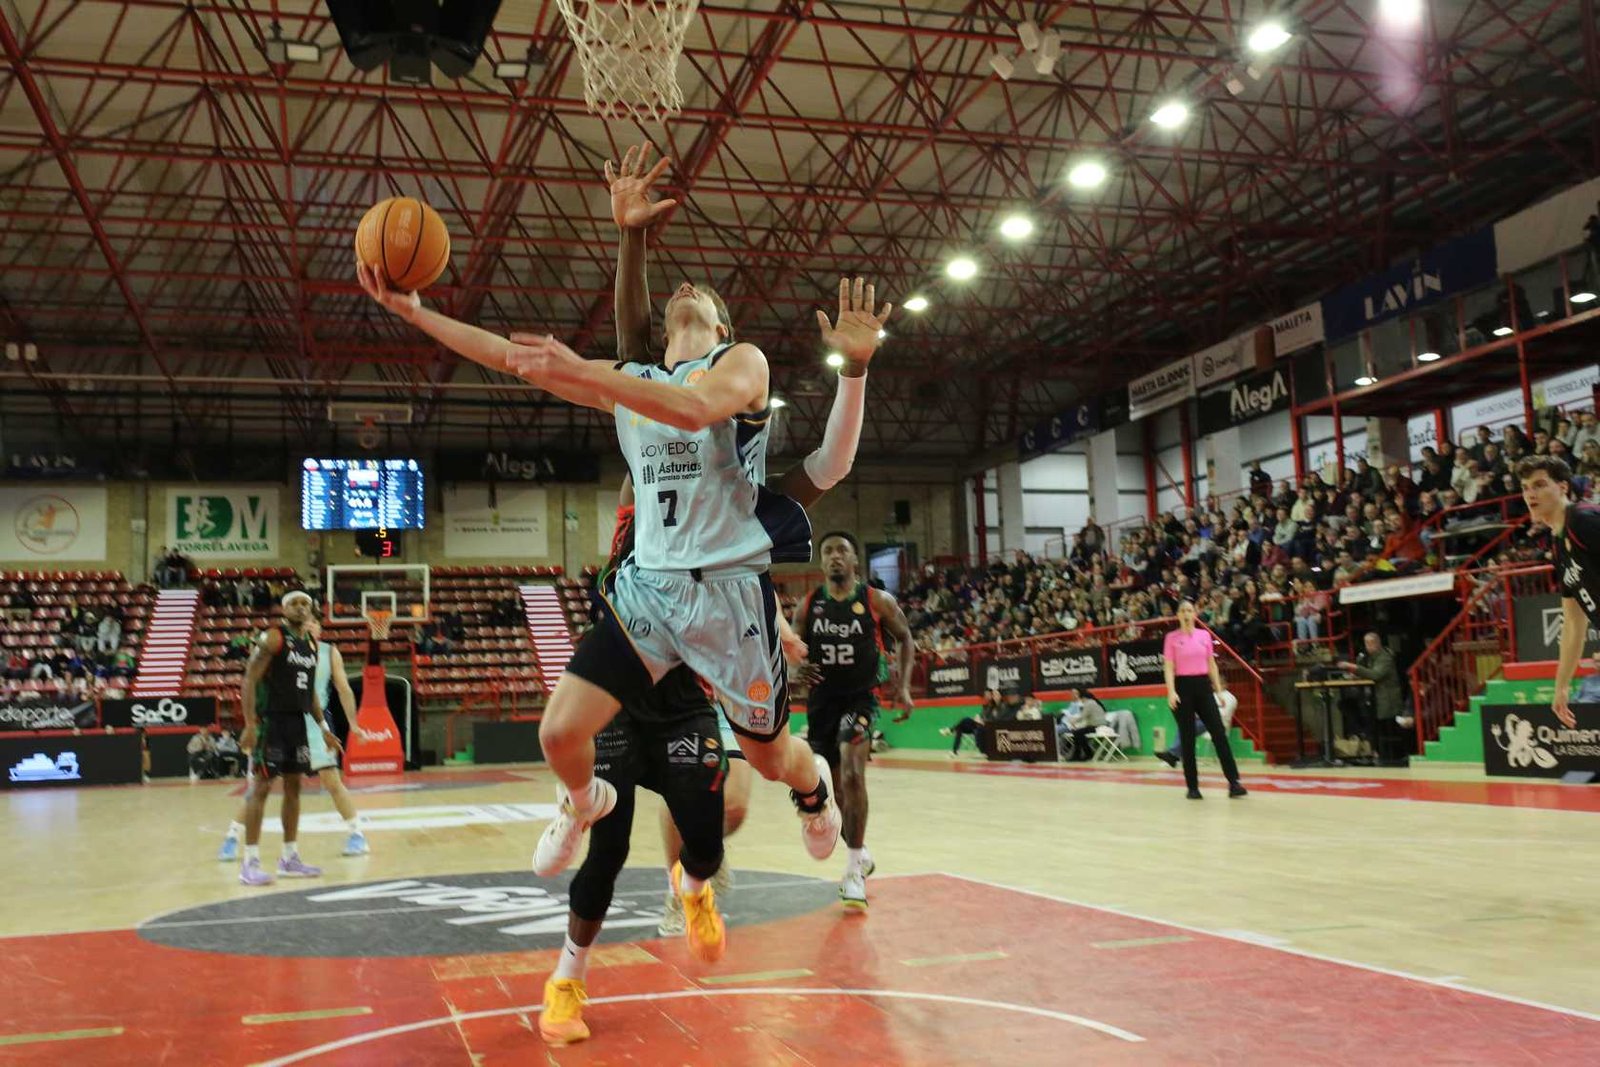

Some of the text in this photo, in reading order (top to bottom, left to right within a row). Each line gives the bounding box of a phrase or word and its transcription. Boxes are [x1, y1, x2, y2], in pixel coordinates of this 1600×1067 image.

[1275, 311, 1312, 334] MALETA
[1230, 370, 1288, 415] AlegA
[645, 441, 699, 457] OVIEDO
[485, 453, 554, 479] AlegA
[658, 462, 702, 475] Asturias
[657, 489, 678, 527] 7
[381, 541, 392, 557] 3
[1578, 587, 1597, 613] 9
[813, 618, 864, 639] AlegA
[821, 643, 855, 665] 32
[295, 671, 309, 690] 2
